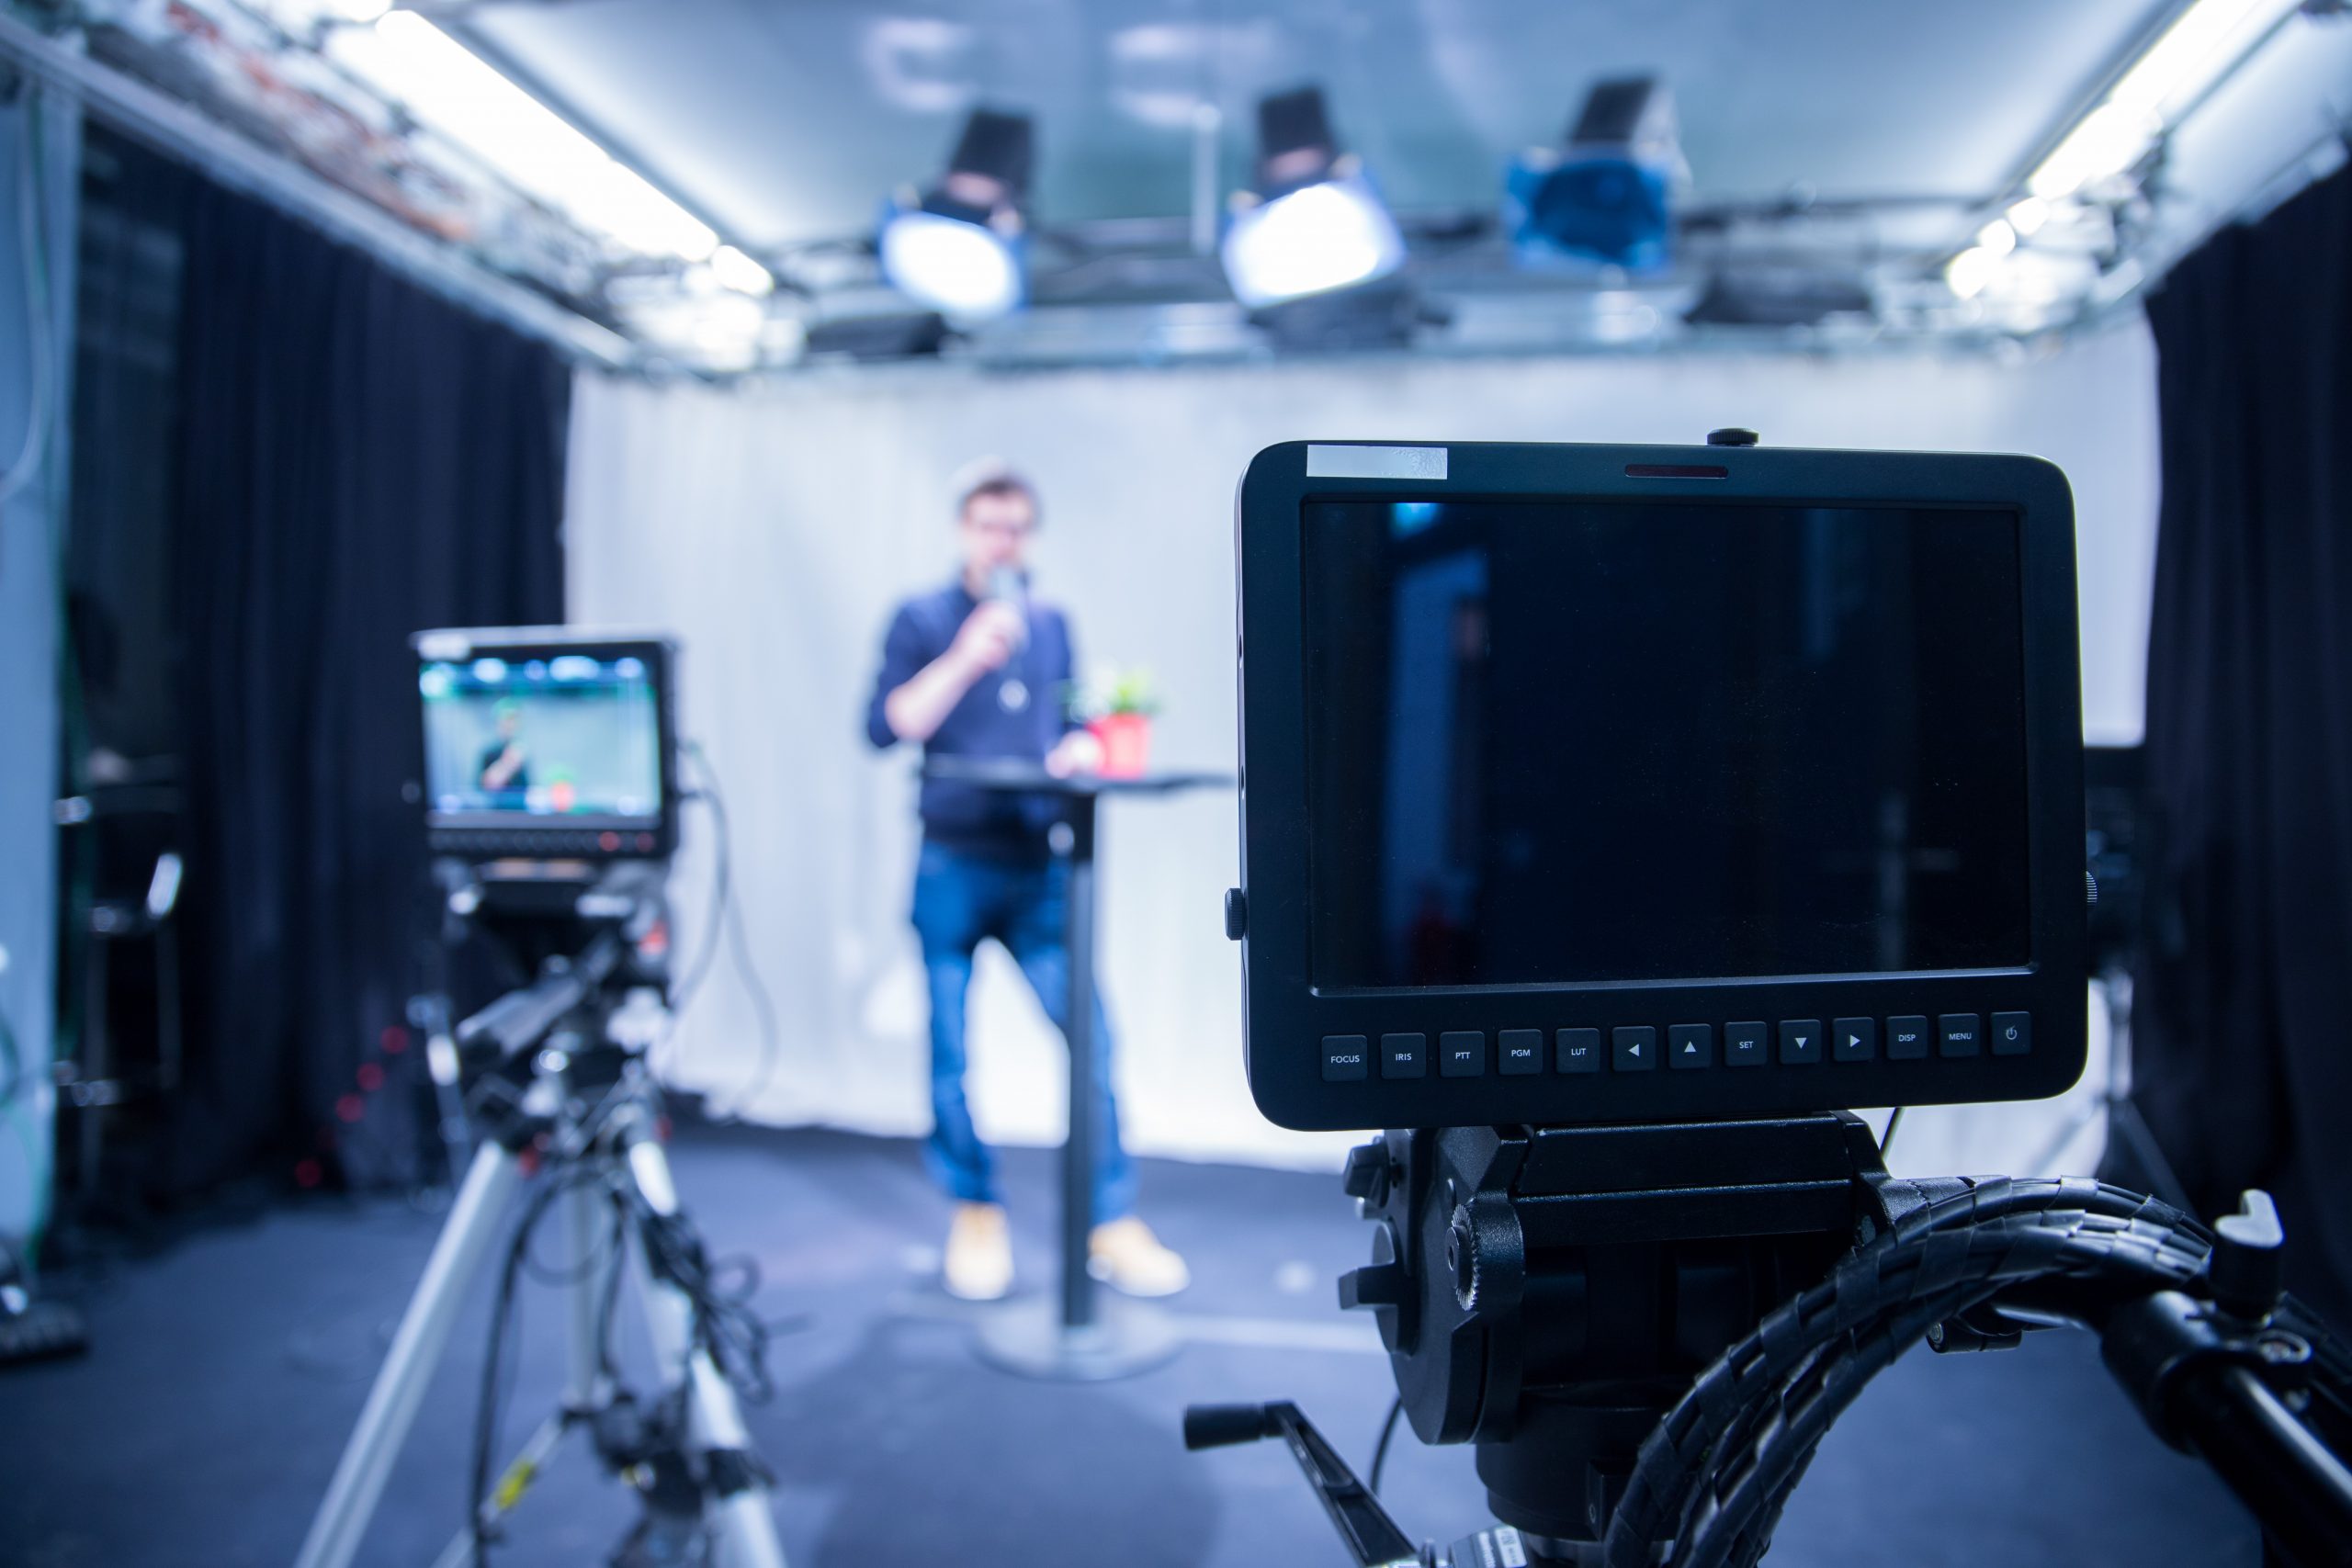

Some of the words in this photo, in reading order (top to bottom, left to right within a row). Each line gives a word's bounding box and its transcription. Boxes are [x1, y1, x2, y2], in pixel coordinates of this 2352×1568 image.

[1898, 1033, 1917, 1043] DISP
[1949, 1032, 1973, 1041] MENU
[1738, 1041, 1754, 1049] SET
[1454, 1051, 1471, 1060] PTT
[1510, 1048, 1531, 1057] PGM
[1570, 1047, 1587, 1056] LUT
[1330, 1055, 1361, 1064] FOCUS
[1395, 1053, 1412, 1061] IRIS
